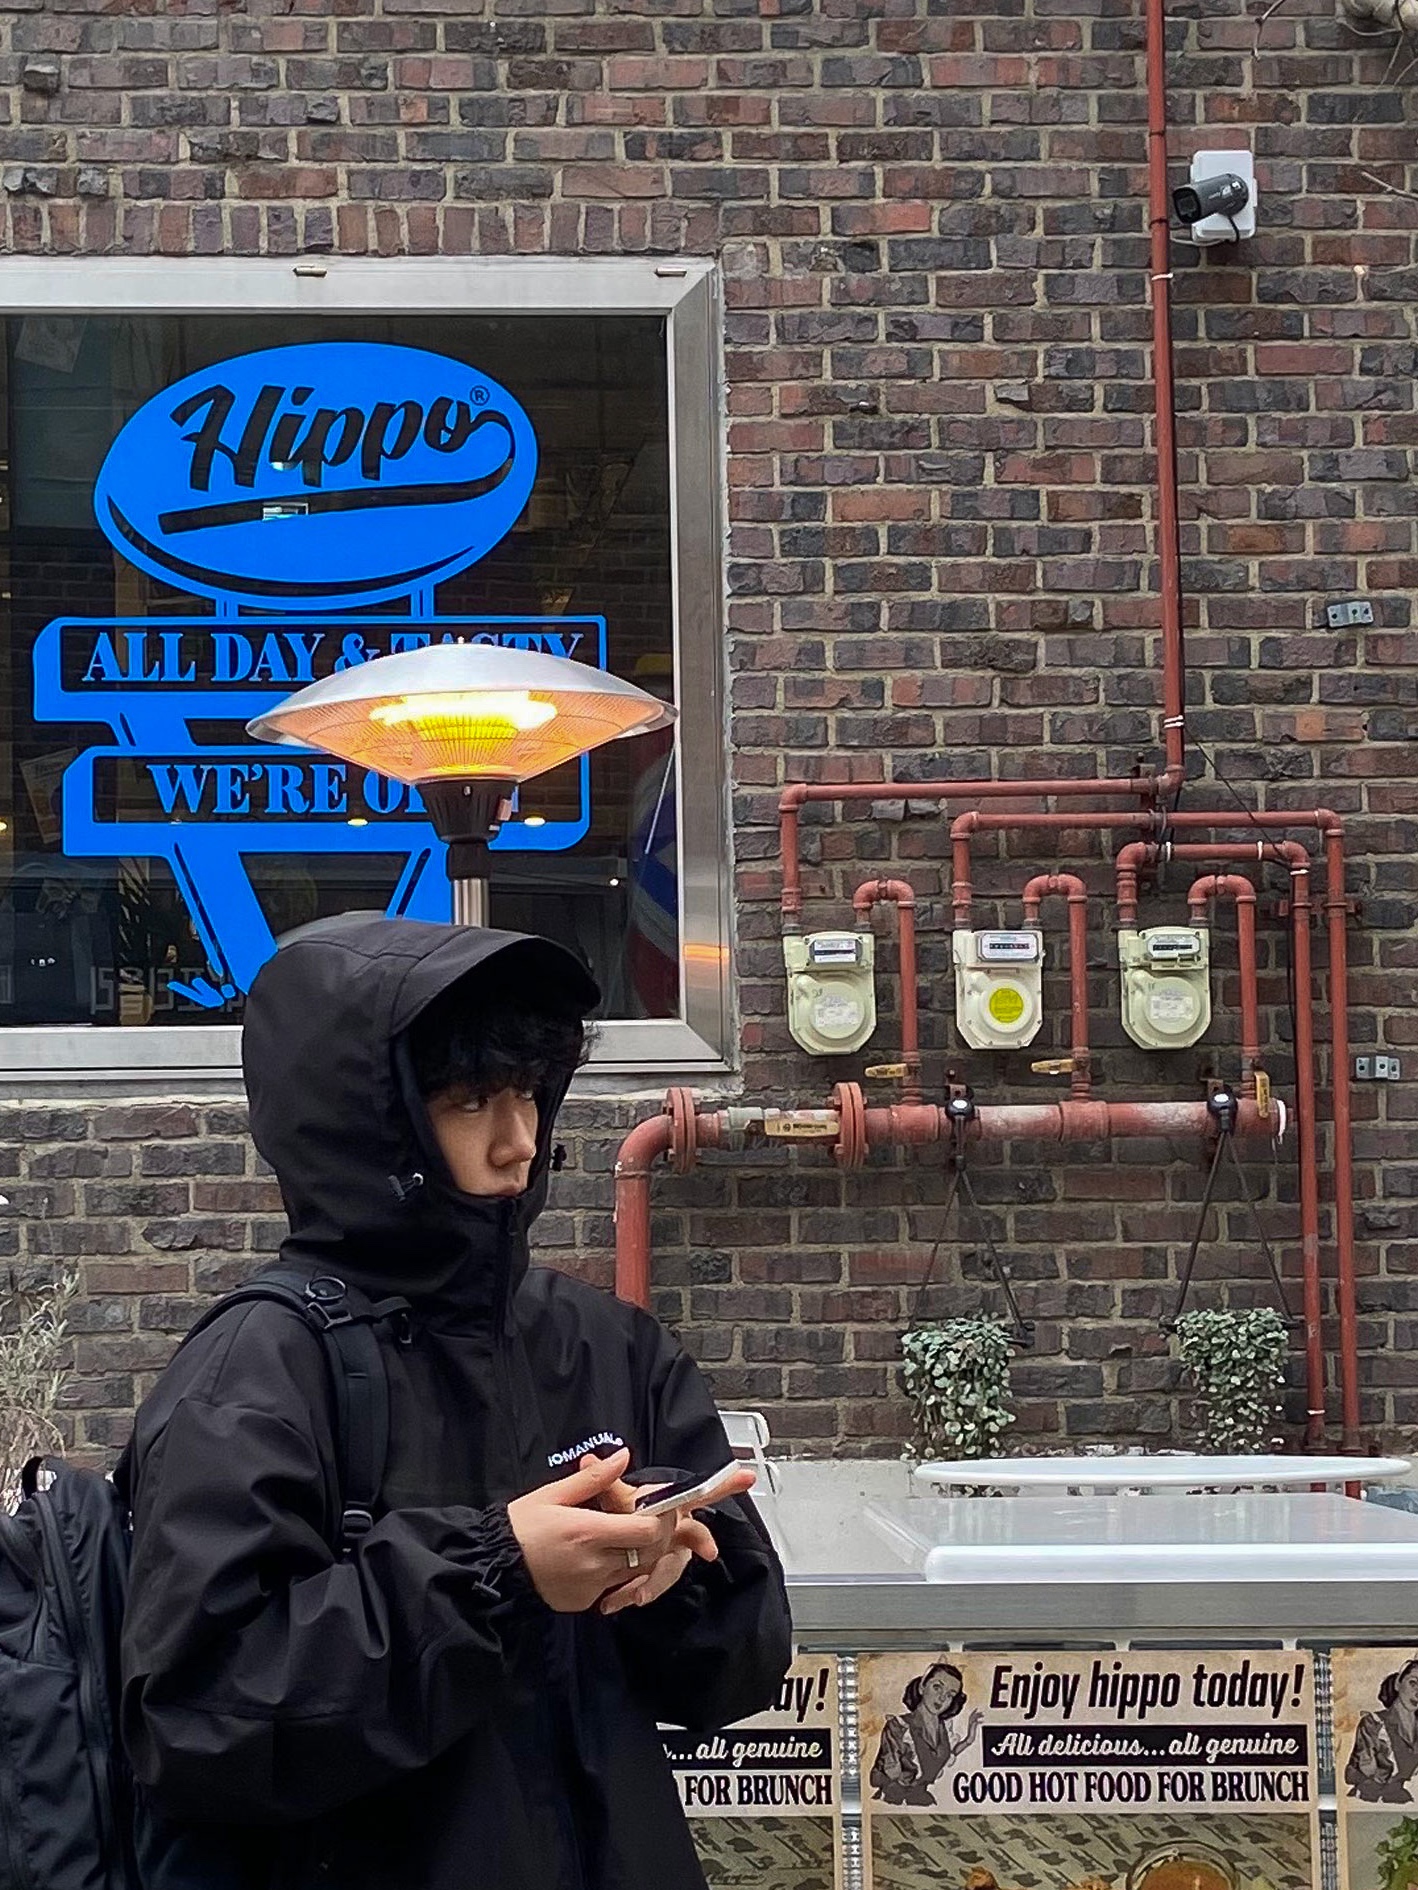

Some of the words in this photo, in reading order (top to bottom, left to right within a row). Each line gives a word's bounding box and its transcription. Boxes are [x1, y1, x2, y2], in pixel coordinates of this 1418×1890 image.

[82, 632, 196, 682] ALL
[211, 632, 325, 682] DAY
[145, 763, 348, 814] WE'RE
[989, 1661, 1081, 1720] Enjoy
[1087, 1660, 1181, 1720] hippo
[1192, 1660, 1305, 1720] today!
[732, 1735, 824, 1768] genuine
[990, 1732, 1035, 1756] All
[1205, 1732, 1300, 1764] genuine
[684, 1775, 733, 1807] FOR
[737, 1774, 833, 1807] BRUNCH
[952, 1771, 1024, 1804] GOOD
[1028, 1771, 1079, 1803] HOT
[1083, 1771, 1152, 1803] FOOD
[1156, 1771, 1207, 1803] FOR
[1210, 1770, 1310, 1803] BRUNCH
